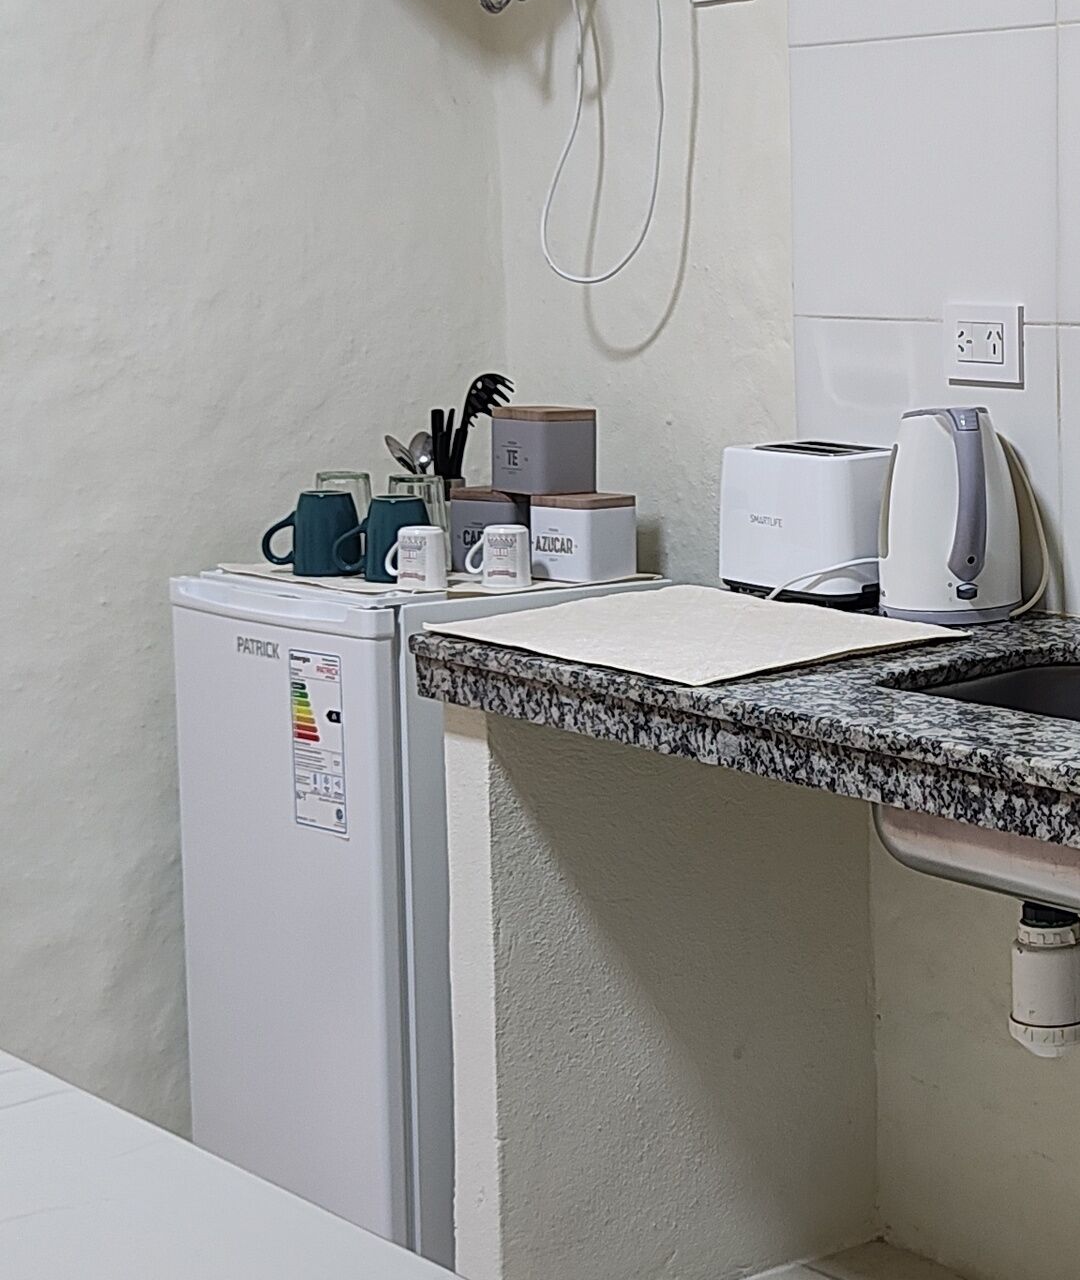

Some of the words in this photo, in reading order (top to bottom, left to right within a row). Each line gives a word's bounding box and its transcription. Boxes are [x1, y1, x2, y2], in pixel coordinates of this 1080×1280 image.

[506, 449, 519, 467] TE
[463, 529, 484, 546] CAF
[535, 535, 573, 554] AZUCAR
[237, 636, 280, 659] PATRICK
